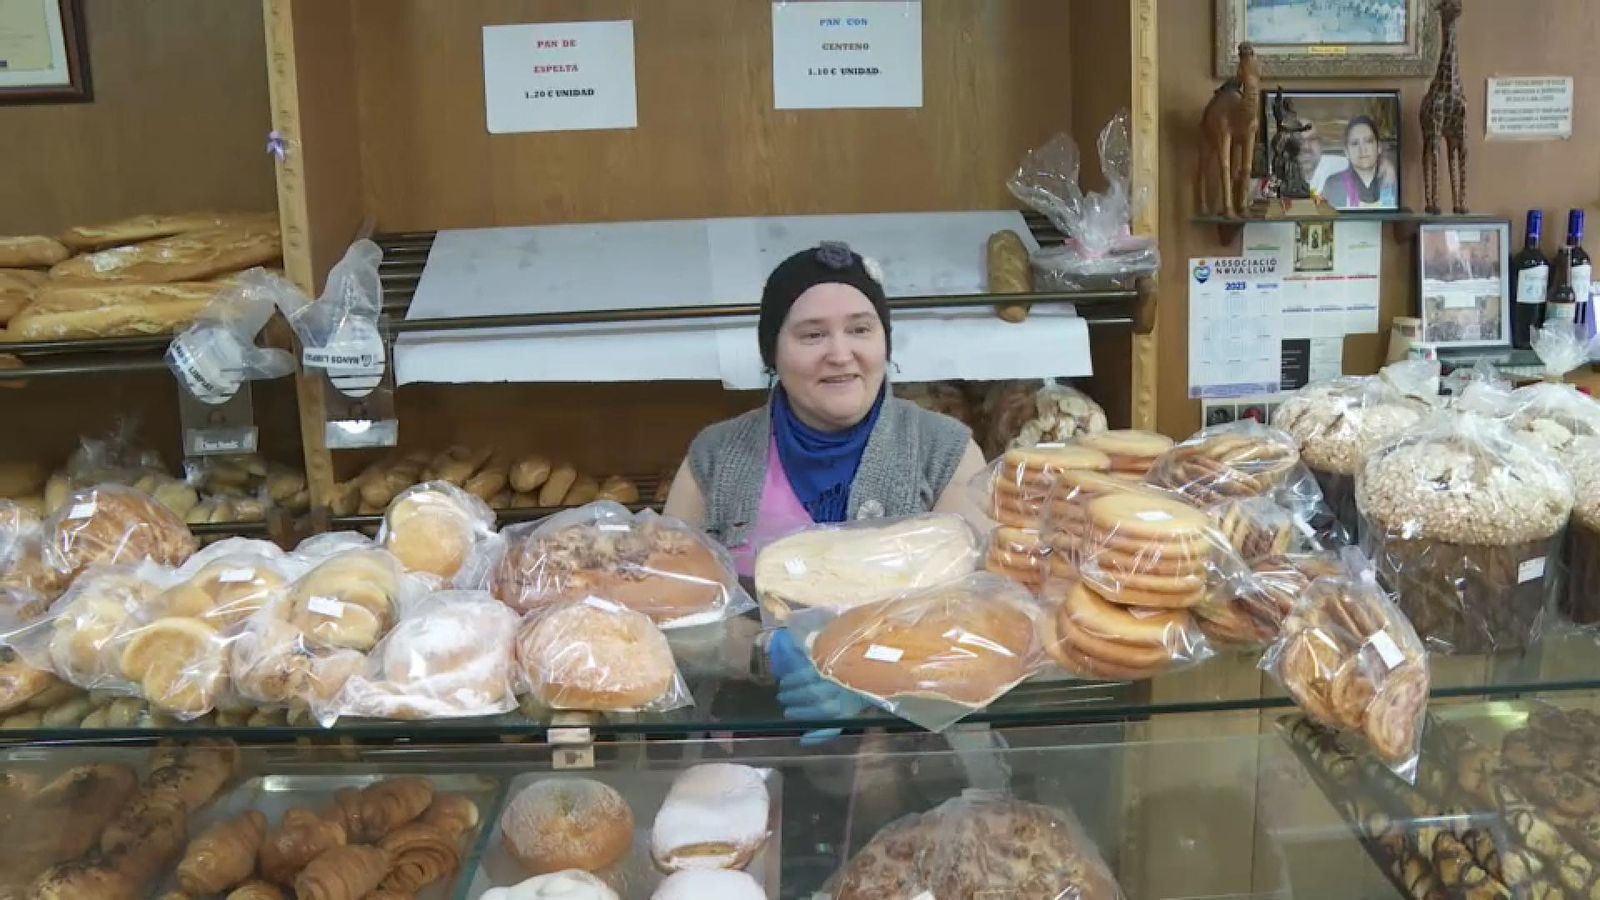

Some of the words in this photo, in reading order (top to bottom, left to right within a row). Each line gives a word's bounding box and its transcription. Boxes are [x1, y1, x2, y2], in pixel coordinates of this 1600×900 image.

[820, 18, 841, 26] PAN
[846, 17, 868, 26] CON
[536, 40, 558, 49] PAN
[562, 39, 577, 48] DE
[822, 42, 870, 51] CENTENO
[534, 64, 579, 74] ESPELTA
[555, 88, 595, 98] UNIDAD
[1224, 281, 1247, 291] 2023
